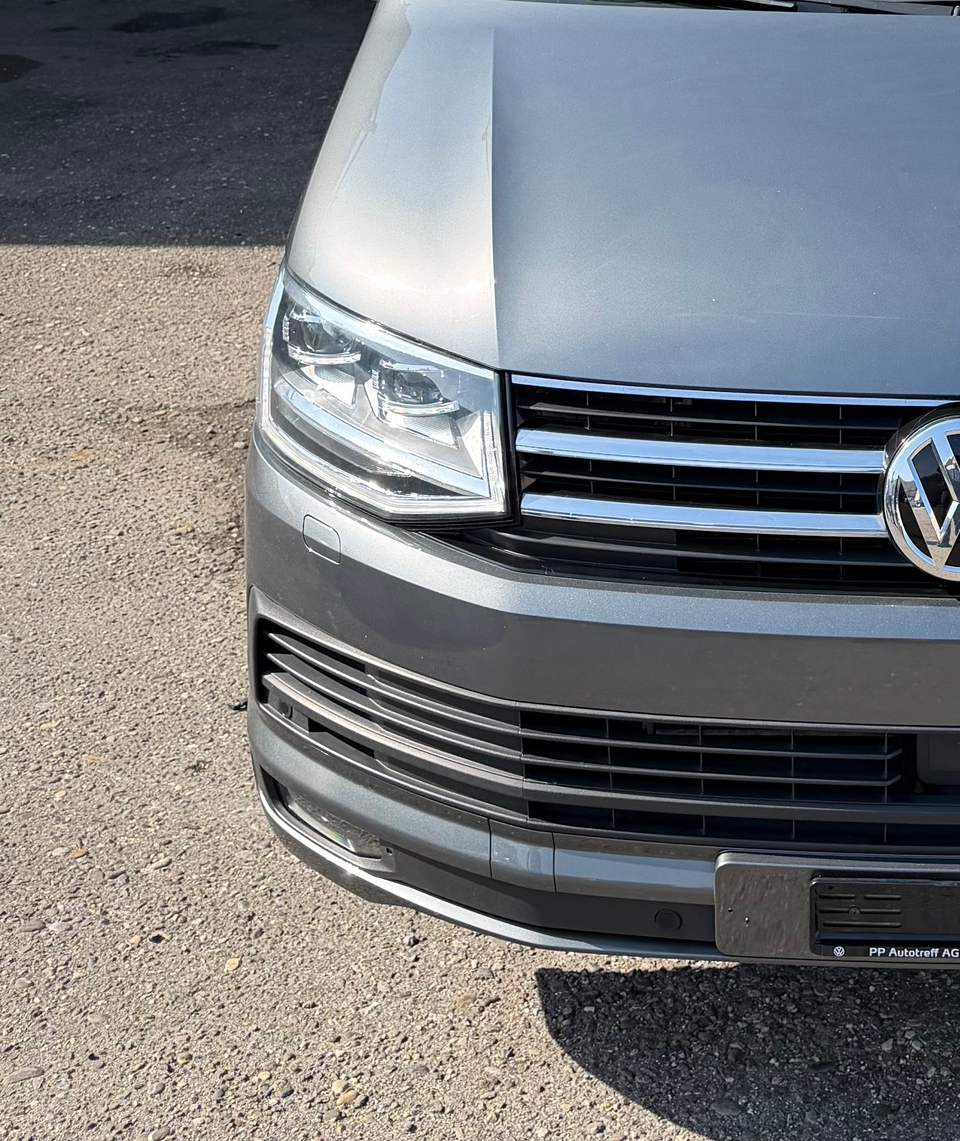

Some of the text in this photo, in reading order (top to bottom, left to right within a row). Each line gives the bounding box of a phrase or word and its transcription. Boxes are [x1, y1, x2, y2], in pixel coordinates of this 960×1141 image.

[869, 947, 885, 957] PP
[889, 947, 938, 958] Autotreff
[942, 948, 959, 958] AG
